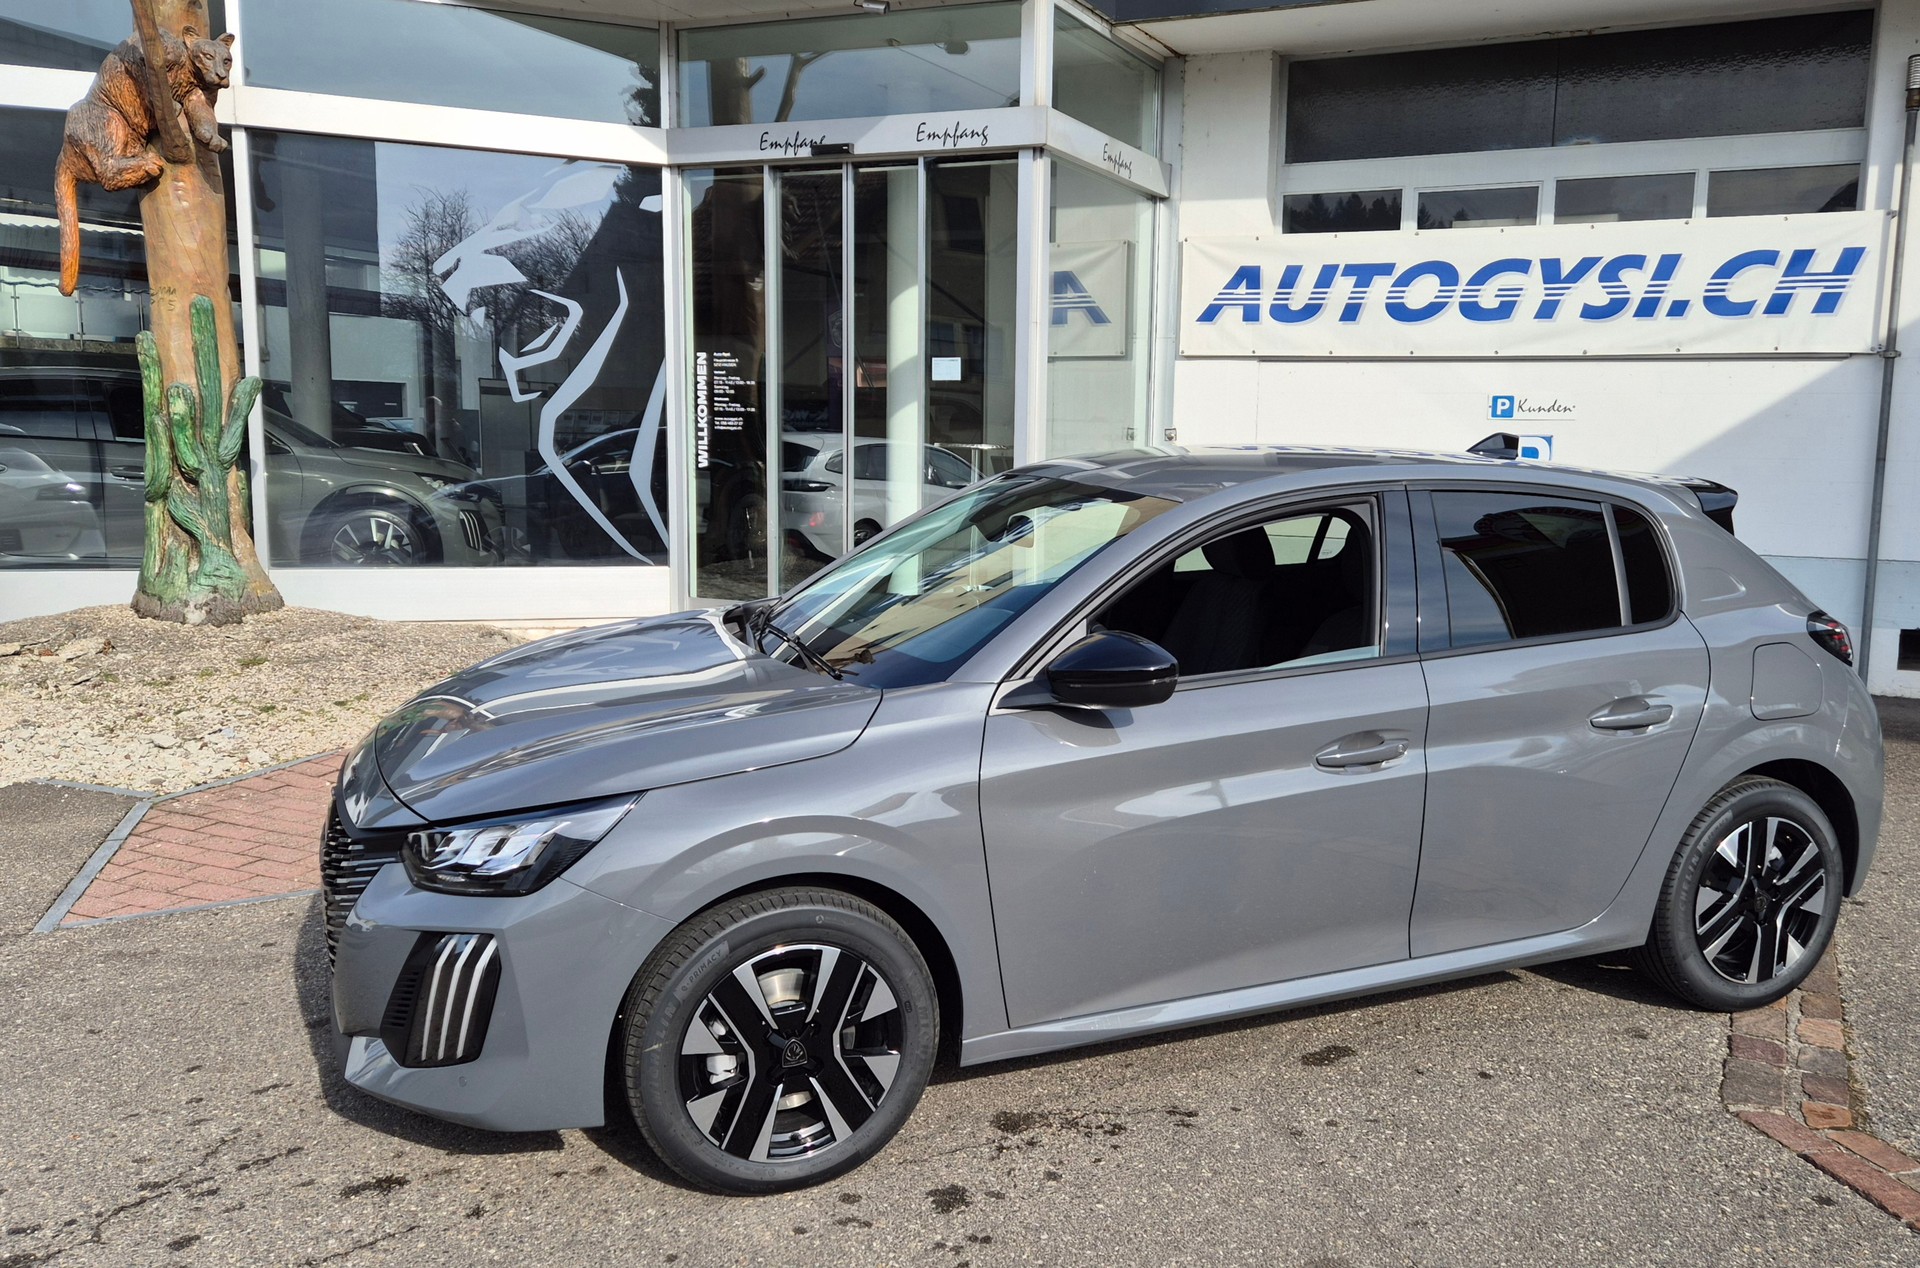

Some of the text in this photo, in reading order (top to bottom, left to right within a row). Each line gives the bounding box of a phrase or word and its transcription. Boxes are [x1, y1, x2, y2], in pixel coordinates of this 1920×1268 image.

[916, 121, 989, 147] Empfang
[1103, 143, 1132, 179] Empfang
[1196, 246, 1867, 323] AUTOGYSI.CH
[696, 352, 709, 468] WILLKOMMEN
[1496, 398, 1573, 415] P Kunden
